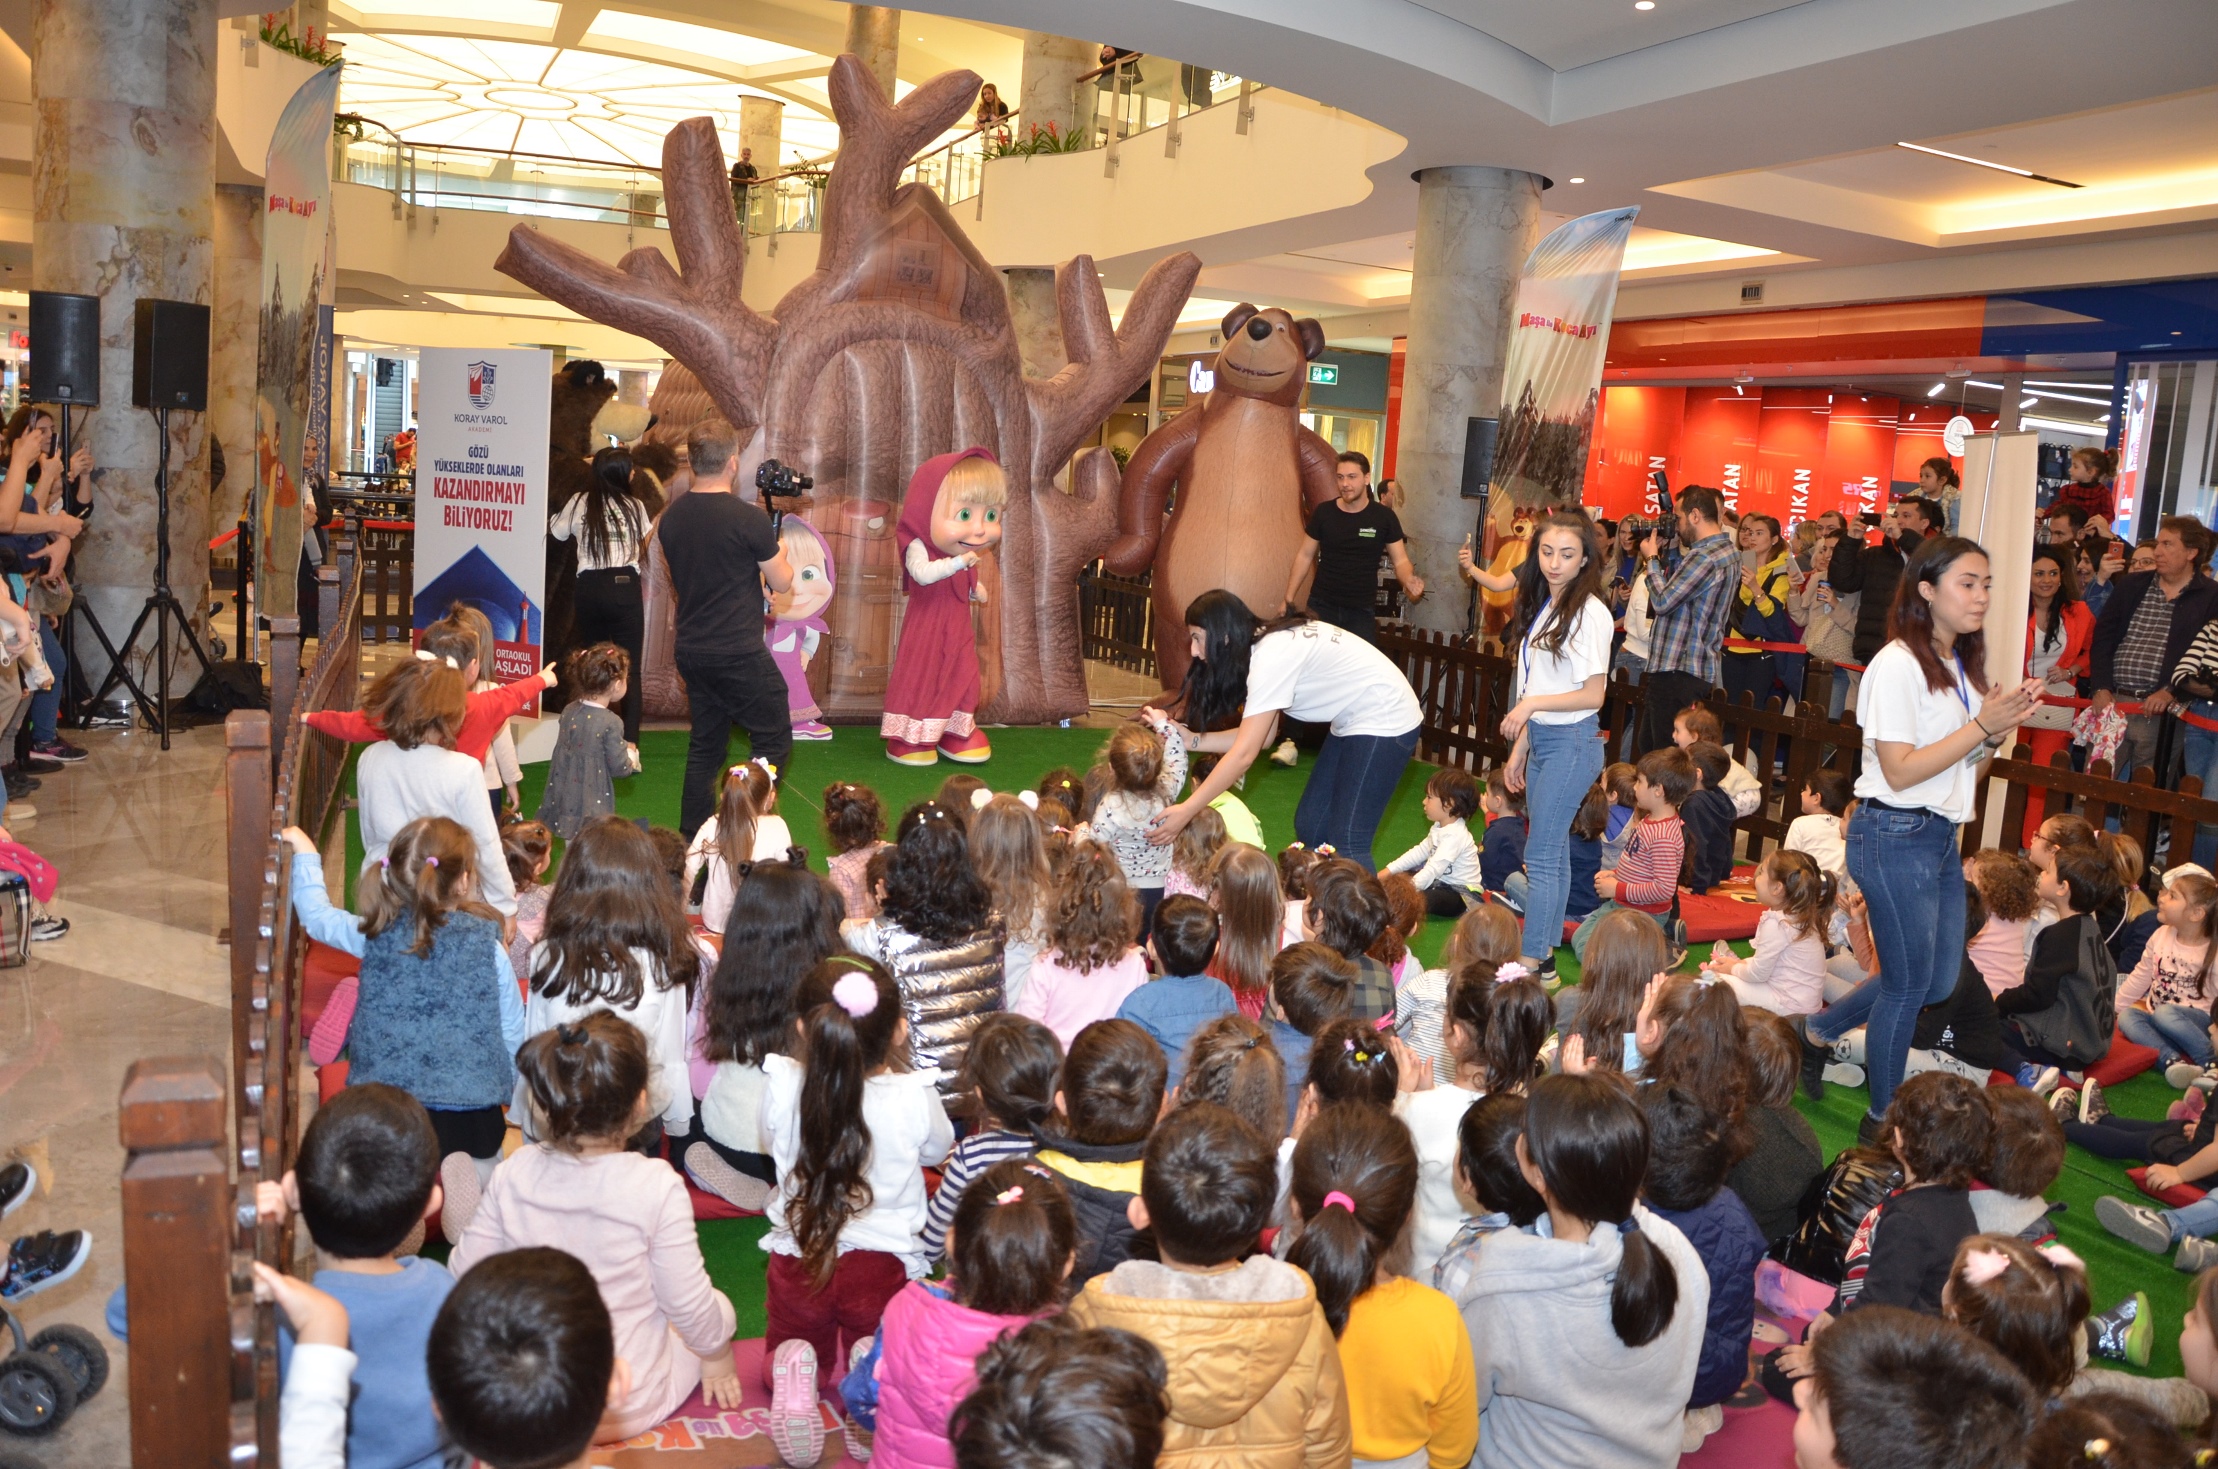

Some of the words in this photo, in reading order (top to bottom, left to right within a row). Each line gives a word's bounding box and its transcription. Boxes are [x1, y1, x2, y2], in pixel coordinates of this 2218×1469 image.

[1520, 313, 1545, 328] Maşa
[1553, 317, 1579, 336] Koca
[1579, 325, 1597, 340] Ayı
[454, 413, 480, 424] KORAY
[482, 415, 508, 425] VAROL
[468, 444, 489, 459] GÖZÜ
[434, 458, 485, 476] YÜKSEKLERDE
[487, 463, 524, 478] OLANLARI
[434, 477, 526, 505] KAZANDIRMAYI
[1722, 464, 1741, 511] ATAN
[496, 649, 531, 662] ORTAOKUL
[495, 660, 532, 676] AŞLADI
